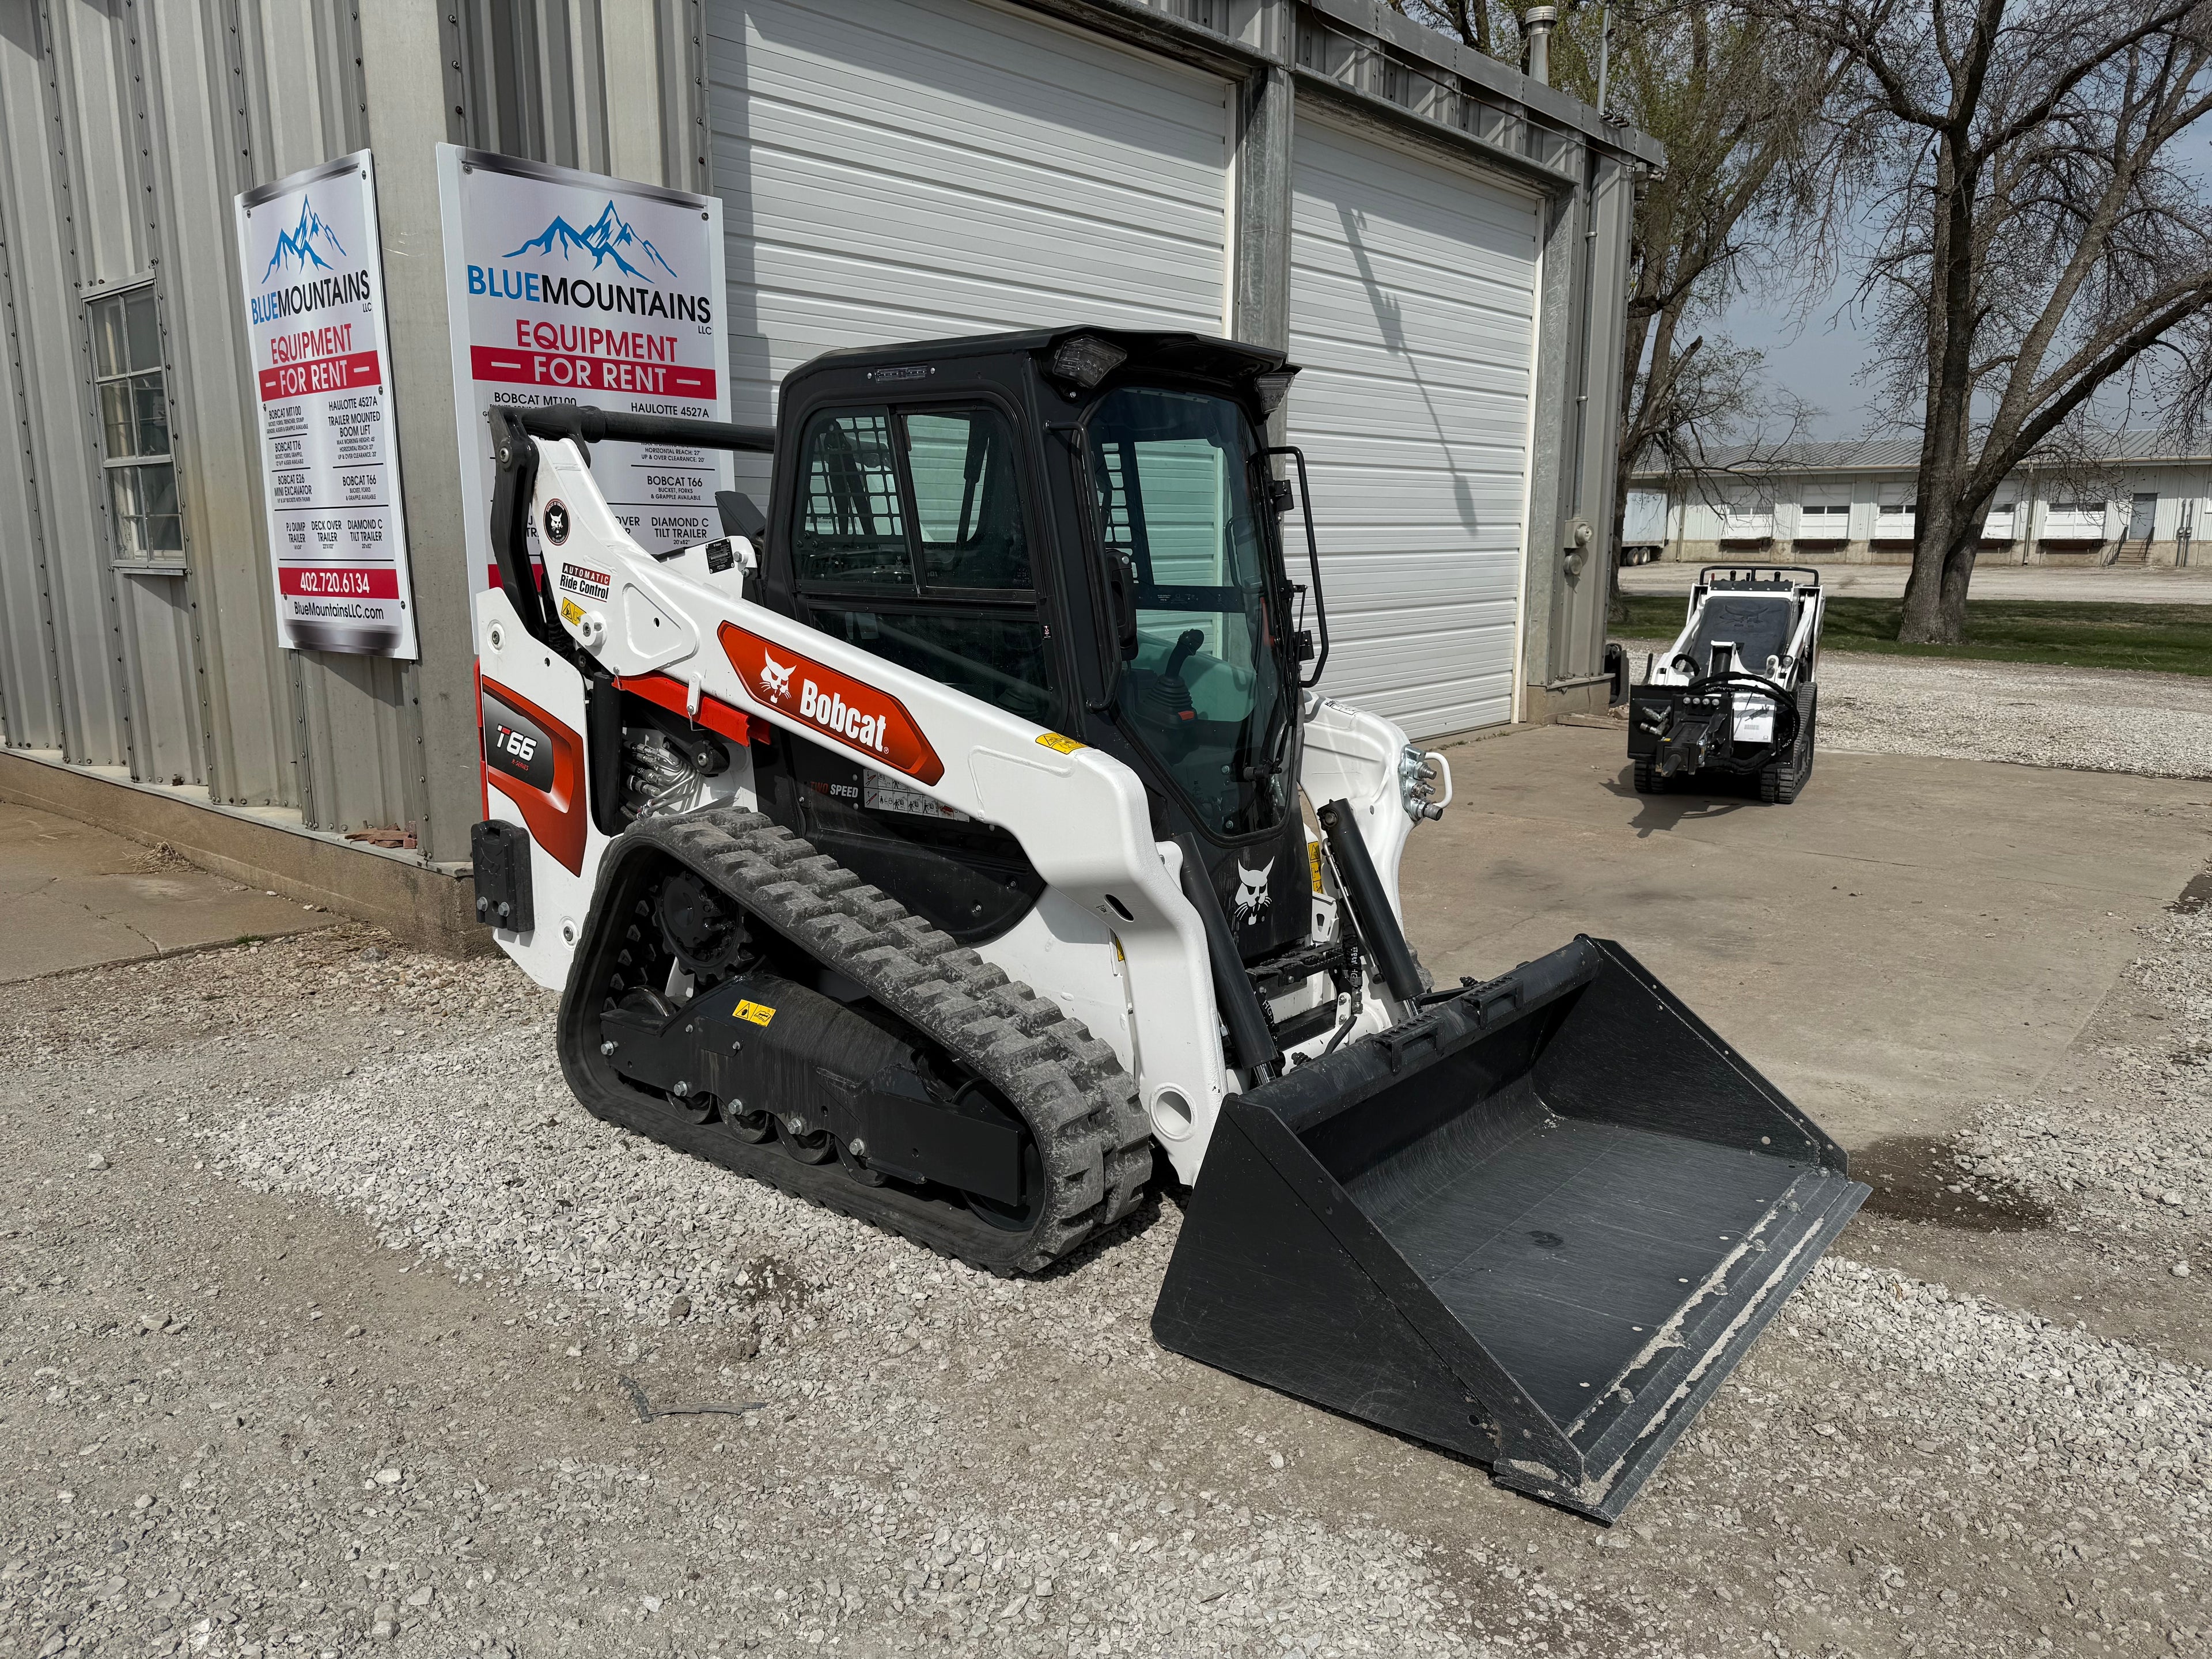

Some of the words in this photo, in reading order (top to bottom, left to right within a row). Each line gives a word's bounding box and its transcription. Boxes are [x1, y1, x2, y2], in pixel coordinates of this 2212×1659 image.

[251, 270, 370, 325] BLUEMOUNTAINS
[467, 264, 711, 324] BLUEMOUNTAINS
[363, 302, 372, 313] LLC
[698, 325, 712, 336] LLC
[271, 323, 351, 364] EQUIPMENT
[516, 319, 677, 362] EQUIPMENT
[279, 365, 307, 395] FOR
[310, 360, 347, 391] RENT
[534, 355, 591, 387] FOR
[603, 362, 666, 393] RENT
[329, 398, 357, 411] HAULOTTE
[359, 396, 377, 407] 4527A
[494, 392, 540, 405] BOBCAT
[269, 408, 285, 420] BOBCAT
[286, 406, 301, 418] MT100
[631, 402, 677, 415] HAULOTTE
[681, 407, 709, 418] 4527A
[328, 414, 350, 426] TRAILER
[351, 411, 380, 424] MOUNTED
[340, 426, 359, 437] BOOM
[360, 425, 370, 435] LIFT
[275, 441, 292, 452] BOBCAT
[293, 440, 301, 450] T76
[278, 475, 294, 485] BOBCAT
[297, 474, 305, 483] E26
[342, 475, 365, 486] BOBCAT
[366, 474, 377, 485] T66
[647, 475, 685, 486] BOBCAT
[688, 478, 703, 487] T66
[274, 487, 284, 497] MINI
[285, 486, 312, 496] EXCAVATOR
[286, 522, 291, 532] PJ
[292, 522, 305, 532] DUMP
[311, 521, 325, 531] DECK
[327, 520, 342, 530] OVER
[347, 519, 376, 529] DIAMOND
[378, 519, 383, 529] C
[652, 517, 699, 527] DIAMOND
[702, 518, 709, 528] C
[288, 533, 305, 543] TRAILER
[317, 532, 338, 542] TRAILER
[350, 532, 359, 541] TILT
[361, 531, 382, 541] TRAILER
[654, 528, 670, 537] TILT
[672, 528, 707, 538] TRAILER
[563, 565, 609, 585] AUTOMATIC
[300, 572, 370, 593] 402.720.6134
[559, 574, 577, 590] Ride
[579, 580, 609, 600] Control
[294, 601, 384, 619] BlueMountainsLLC.com
[800, 678, 887, 752] Bobcat
[497, 725, 537, 761] T66
[810, 781, 830, 794] TWO
[830, 784, 859, 798] SPEED
